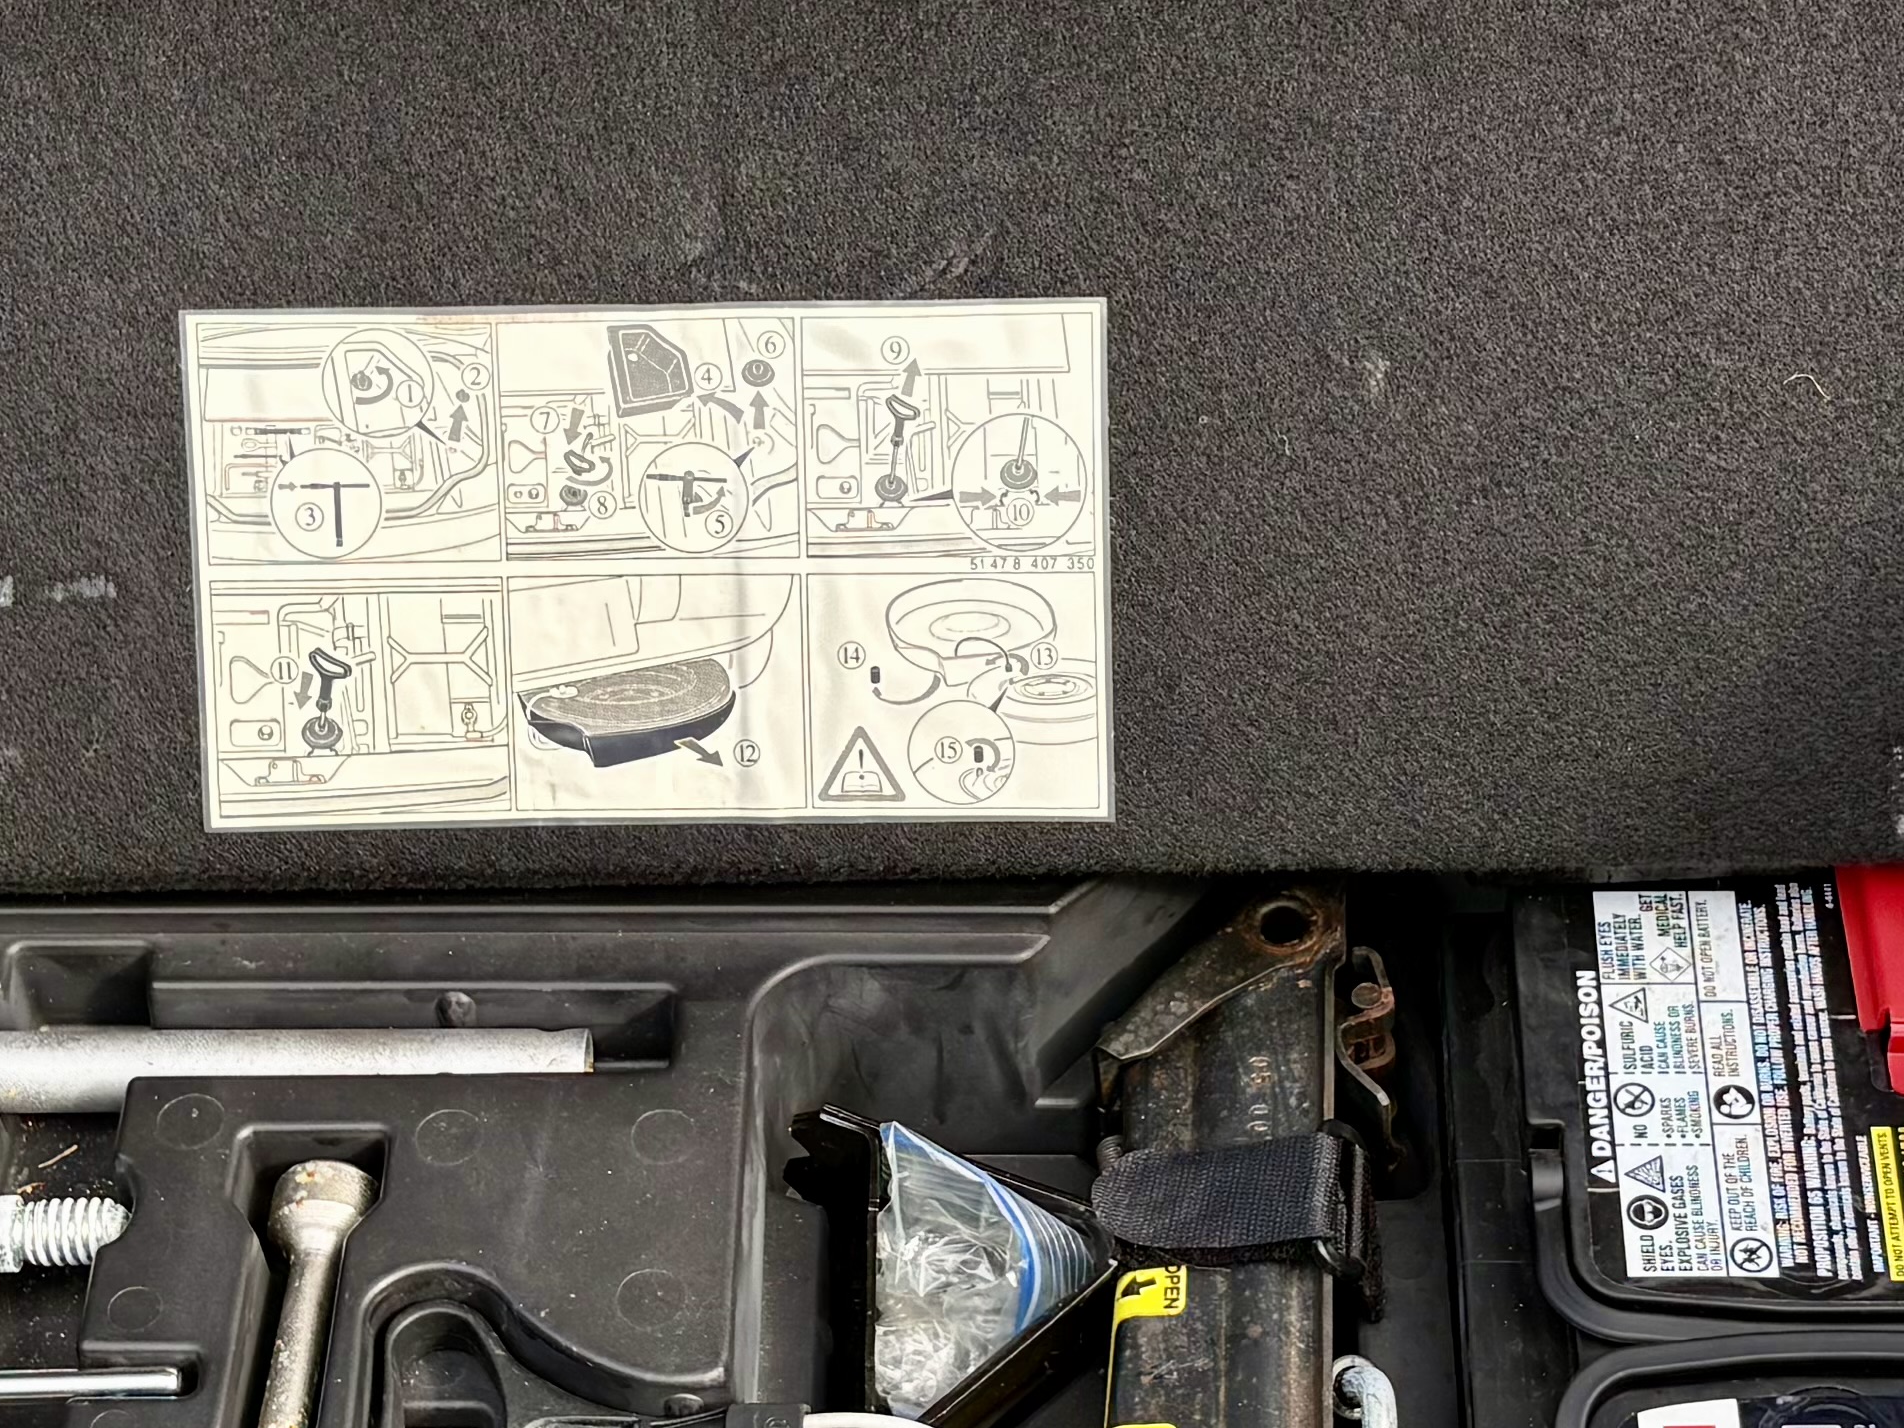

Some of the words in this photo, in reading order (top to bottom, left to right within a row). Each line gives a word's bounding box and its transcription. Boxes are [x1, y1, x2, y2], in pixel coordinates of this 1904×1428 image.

[1013, 557, 1020, 570] 8
[1031, 557, 1057, 570] 407
[1067, 557, 1094, 570] 350
[1638, 894, 1653, 912] GET
[1654, 894, 1671, 937] MEDICAL
[1669, 894, 1685, 920] FAST.
[1695, 900, 1710, 937] BATTERY.
[1598, 922, 1611, 946] EYES
[1628, 914, 1644, 951] WATER.
[1673, 924, 1687, 948] HELP
[1612, 913, 1631, 980] IMMEDIATELY
[1699, 941, 1713, 963] OPEN
[1600, 949, 1614, 980] FLUSH
[1631, 954, 1647, 980] WITH
[1701, 966, 1715, 982] NOT
[1703, 986, 1717, 997] DO
[1667, 1006, 1679, 1018] OR
[1683, 1001, 1696, 1033] BURNS.
[1619, 1021, 1637, 1070] SULFURIC
[1653, 1021, 1667, 1049] CAUSE
[1669, 1021, 1685, 1069] BLINDNESS
[1709, 1035, 1722, 1050] ALL
[1721, 1009, 1740, 1077] INSTRUCTIONS.
[1576, 971, 1613, 1157] DANGER/POISON
[1640, 1045, 1654, 1069] ACID
[1656, 1050, 1669, 1069] CAN
[1686, 1037, 1700, 1069] SEVERE
[1711, 1054, 1725, 1077] READ
[1674, 1097, 1688, 1133] FLAMES
[1688, 1091, 1703, 1133] SMOKING
[1633, 1125, 1648, 1138] NO
[1722, 1153, 1735, 1169] THE
[1735, 1135, 1752, 1183] CHILDREN.
[1800, 1136, 1821, 1189] WARNING:
[1725, 1173, 1737, 1183] OF
[1881, 1162, 1893, 1186] OPEN
[1669, 1175, 1686, 1209] GASES
[1686, 1165, 1702, 1216] BLINDNESS
[1726, 1188, 1740, 1205] OUT
[1740, 1186, 1754, 1197] OF
[1806, 1191, 1823, 1204] 65
[1885, 1188, 1895, 1198] TO
[1728, 1208, 1743, 1231] KEEP
[1741, 1201, 1758, 1231] REACH
[1887, 1202, 1901, 1241] ATTEMPT
[1674, 1213, 1693, 1271] EXPLOSIVE
[1692, 1220, 1706, 1250] CAUSE
[1808, 1206, 1833, 1277] PROPOSITION
[1640, 1235, 1657, 1271] SHIELD
[1659, 1241, 1675, 1271] EYES.
[1697, 1253, 1709, 1271] CAN
[1893, 1244, 1904, 1261] NOT
